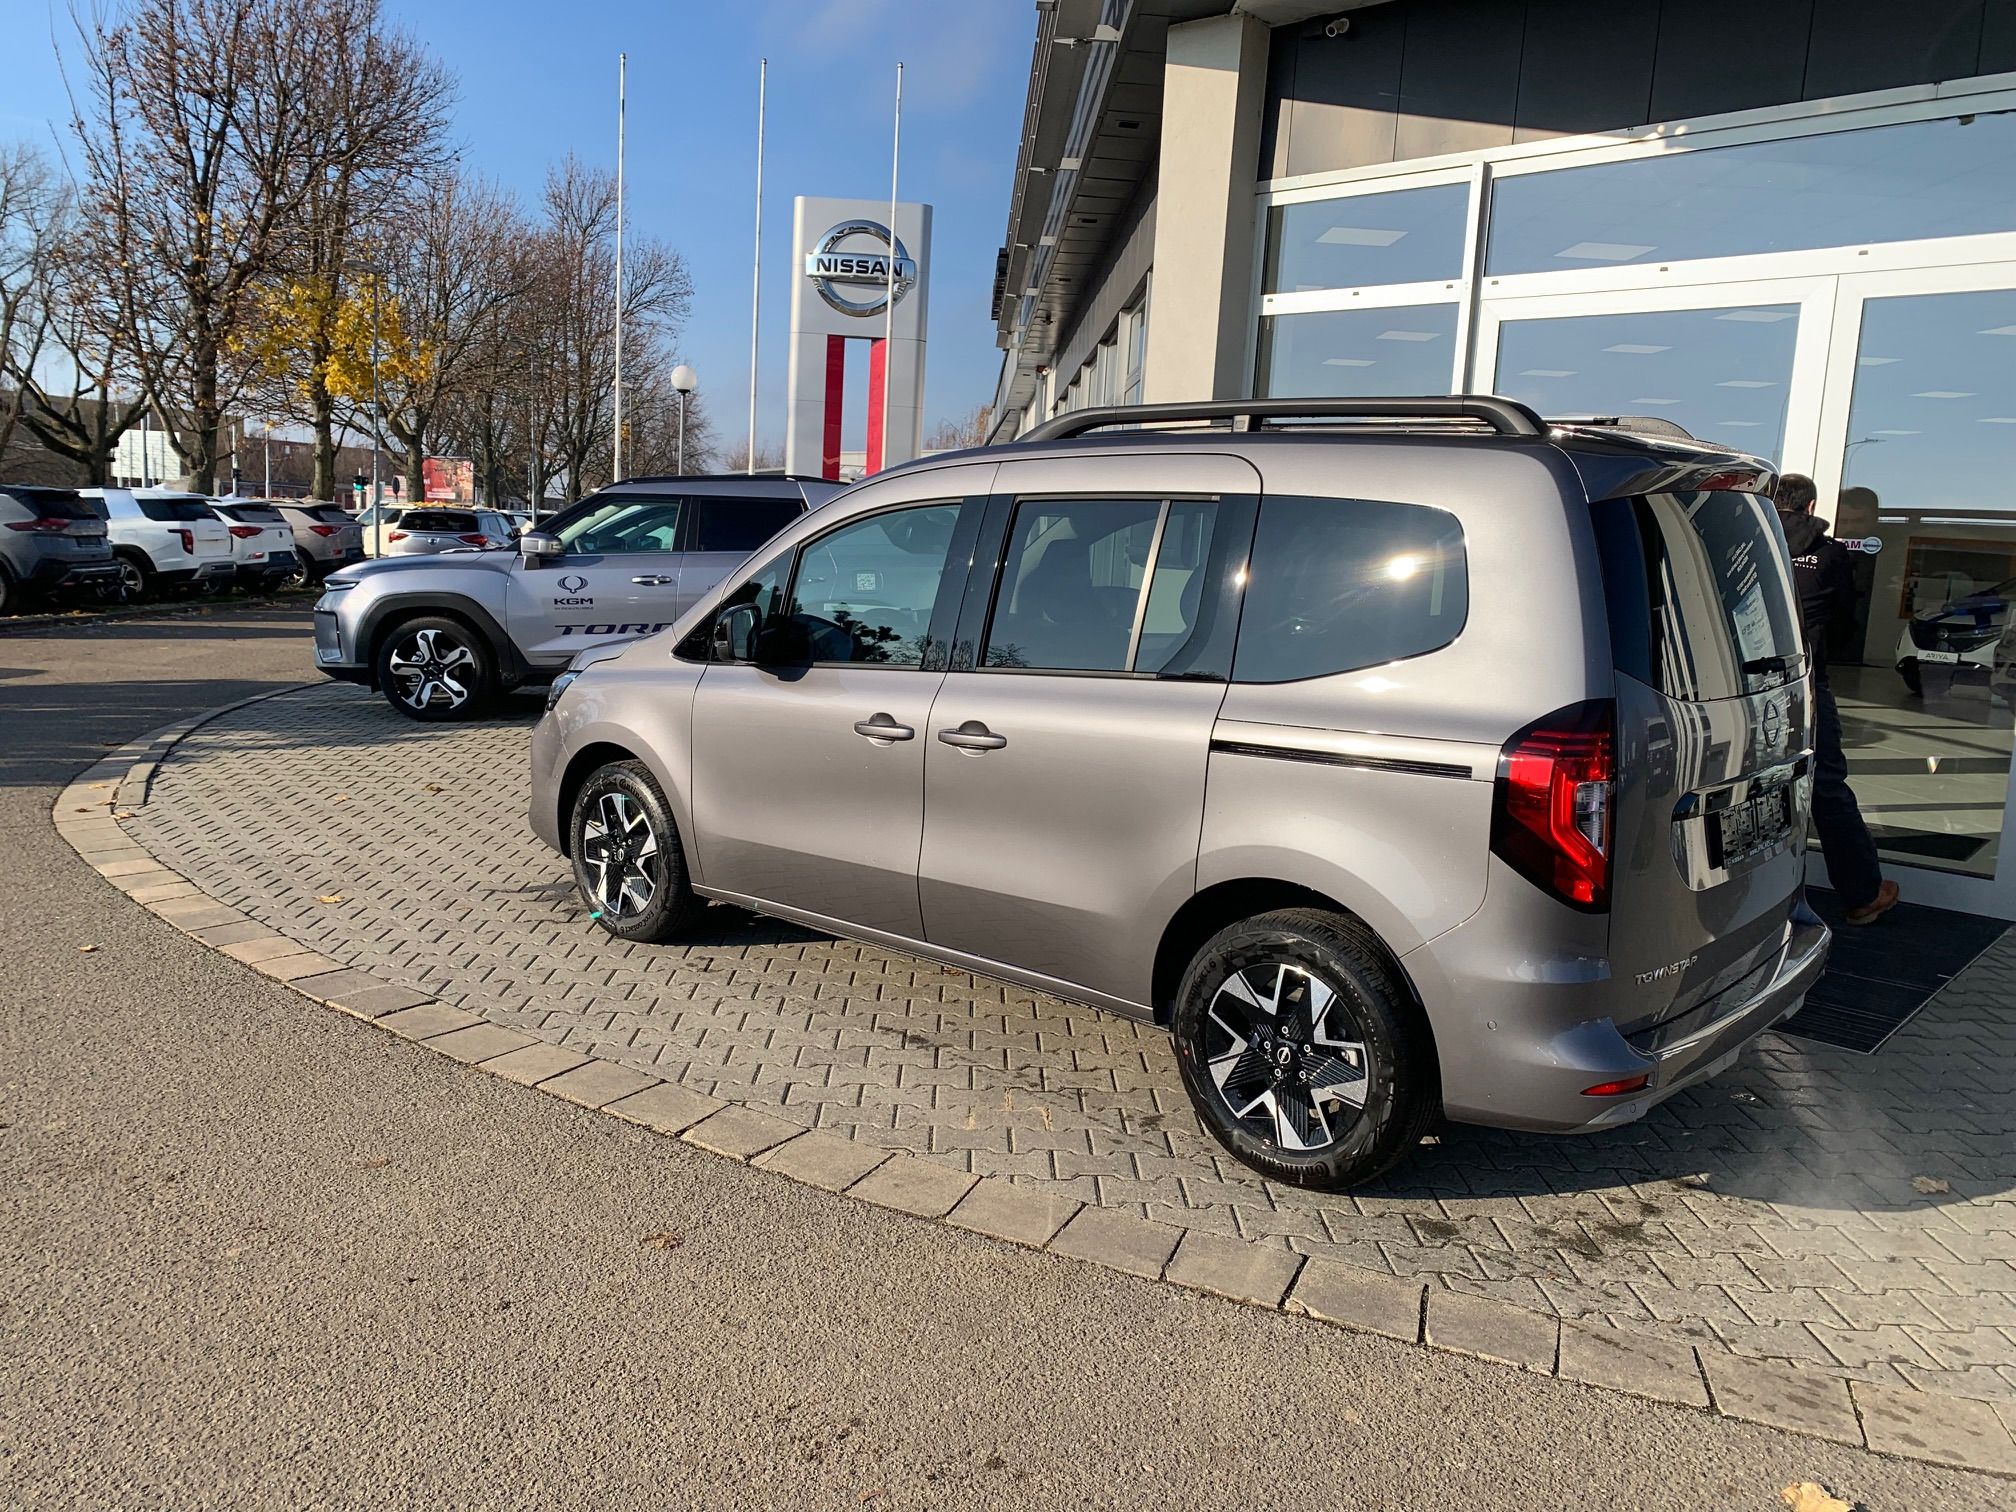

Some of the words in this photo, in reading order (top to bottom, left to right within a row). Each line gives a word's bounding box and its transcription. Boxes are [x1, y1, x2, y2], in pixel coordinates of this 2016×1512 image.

[816, 258, 903, 277] NISSAN
[554, 597, 594, 606] KGM
[1635, 955, 1698, 985] TOWNSTAR
